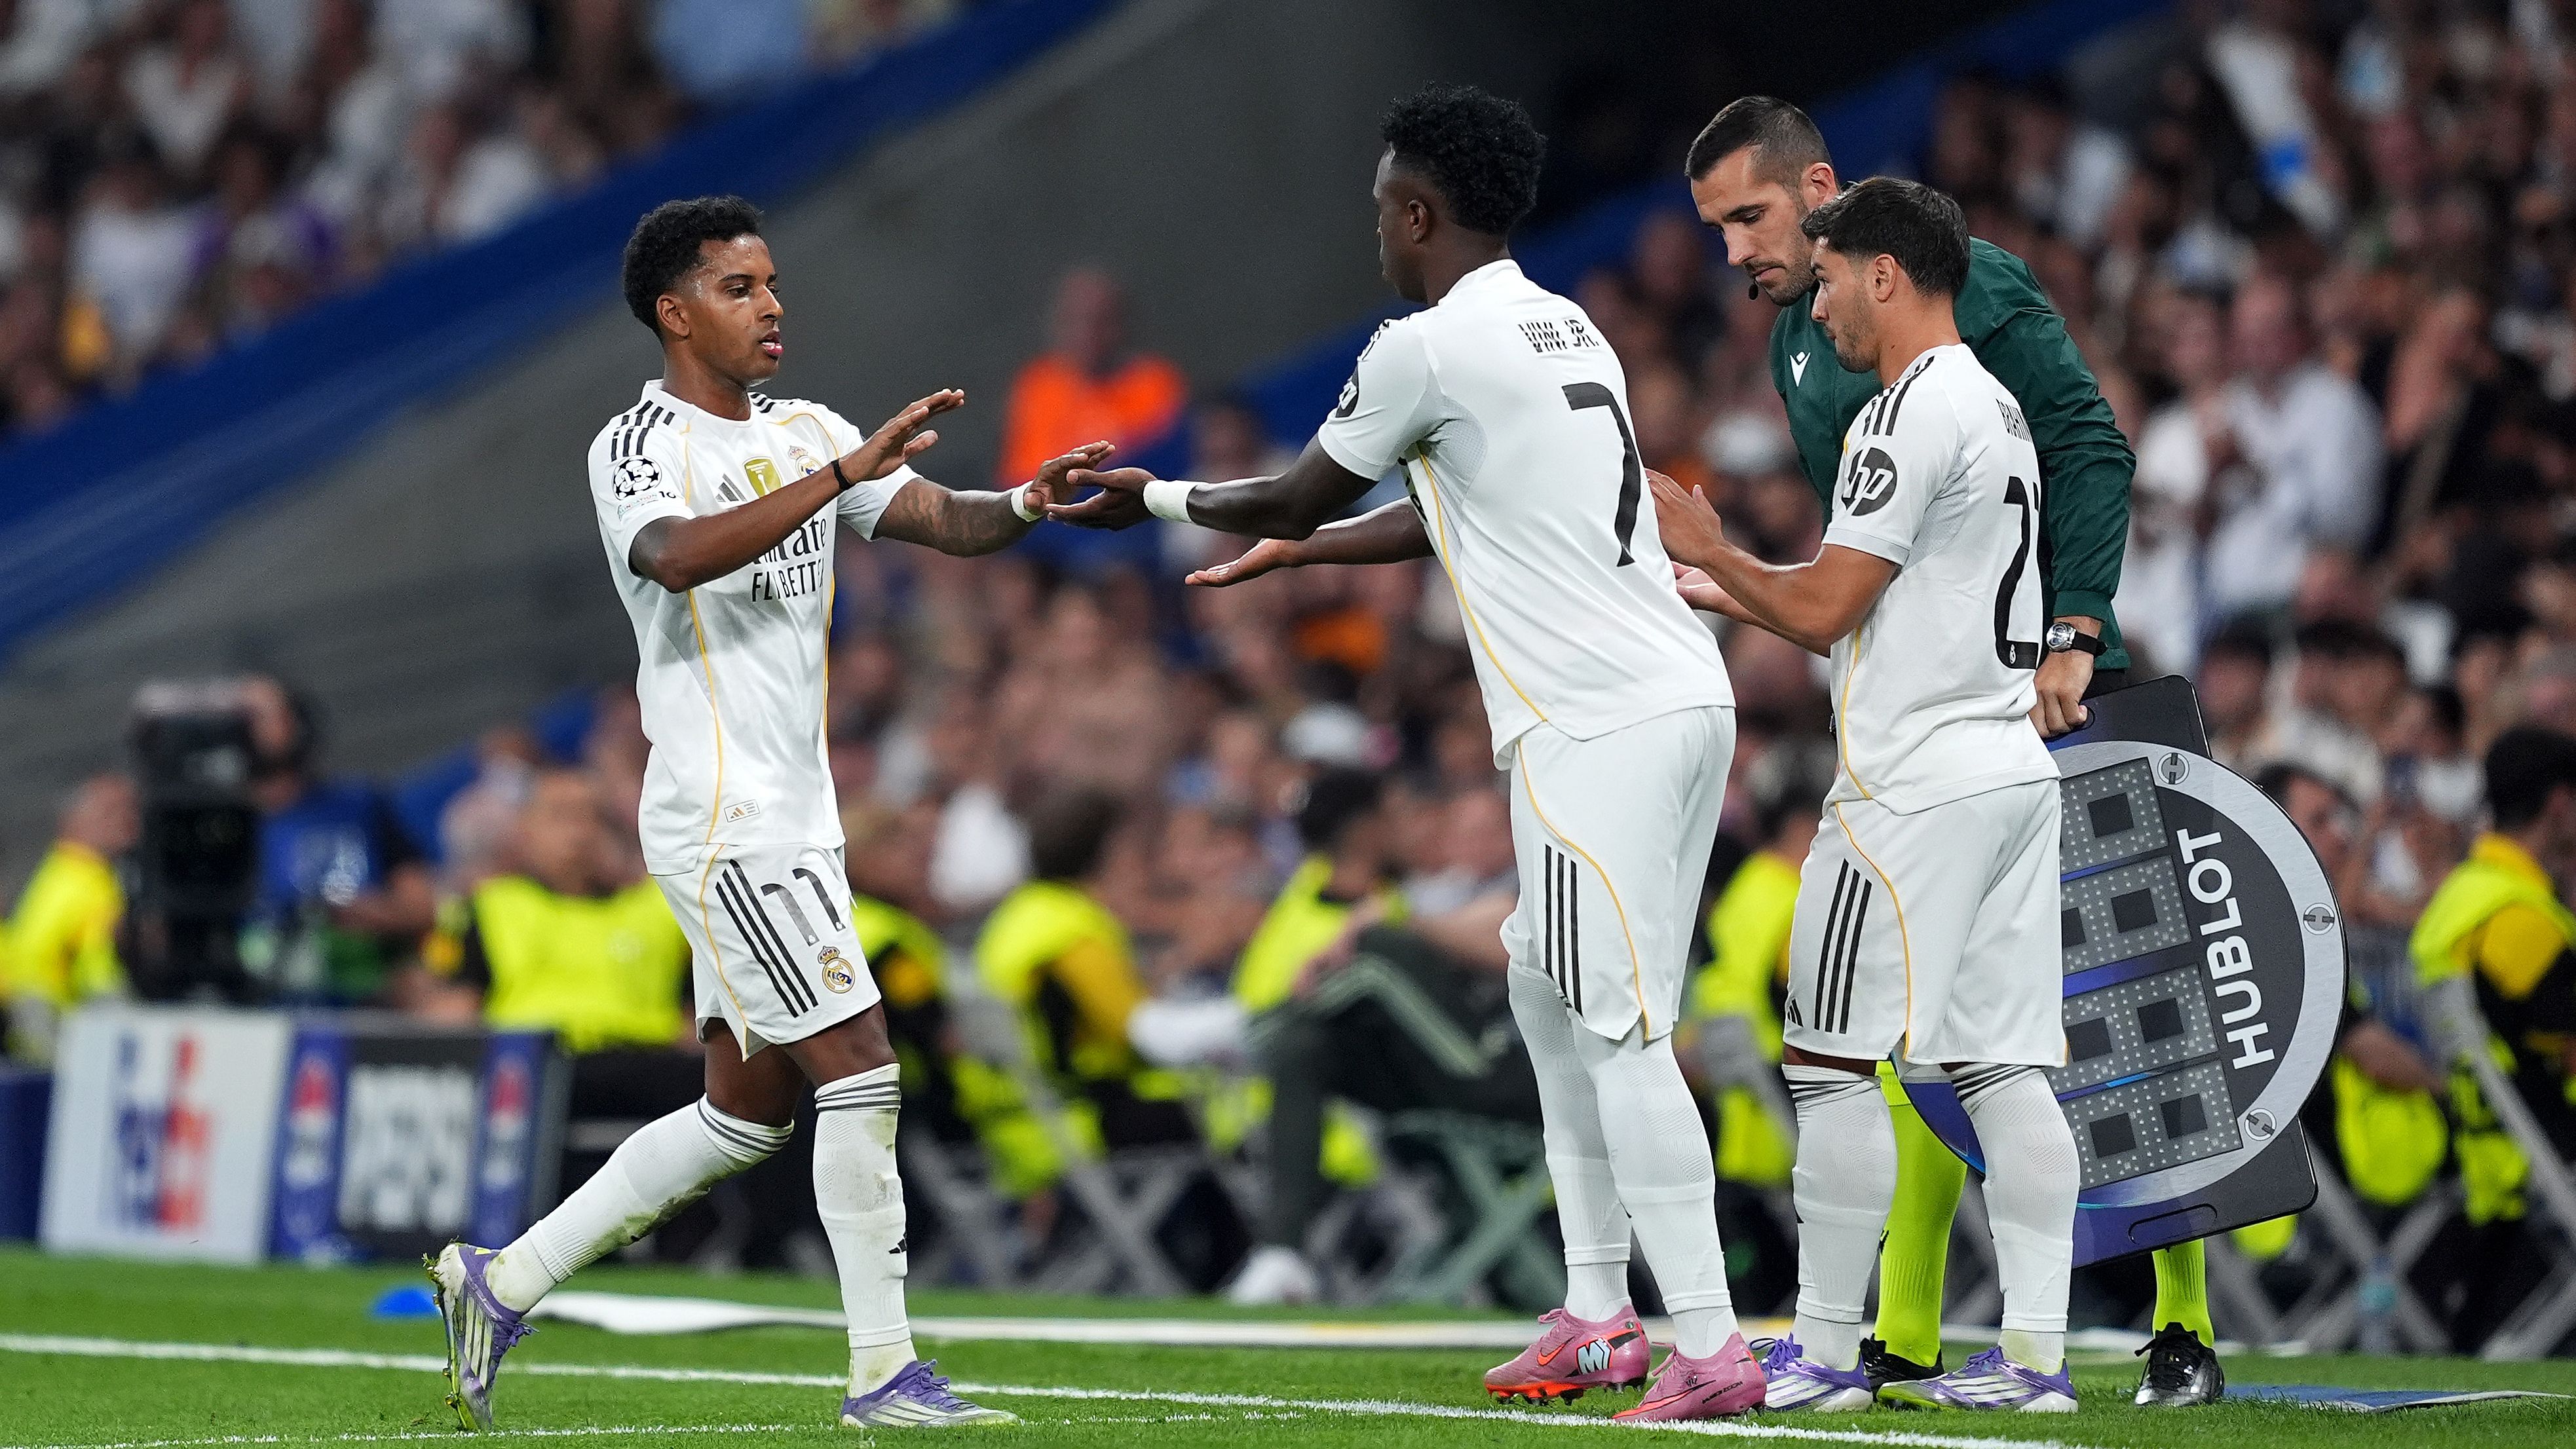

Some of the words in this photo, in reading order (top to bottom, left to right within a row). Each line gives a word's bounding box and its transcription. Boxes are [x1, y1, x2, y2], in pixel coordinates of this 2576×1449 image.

[1518, 322, 1568, 352] VINI
[1564, 320, 1599, 347] JR.
[620, 465, 647, 489] 15
[1561, 382, 1641, 568] 7
[1842, 447, 1896, 516] hp
[1994, 476, 2040, 669] 2
[760, 868, 846, 947] 11
[2177, 827, 2275, 1070] HUBLOT
